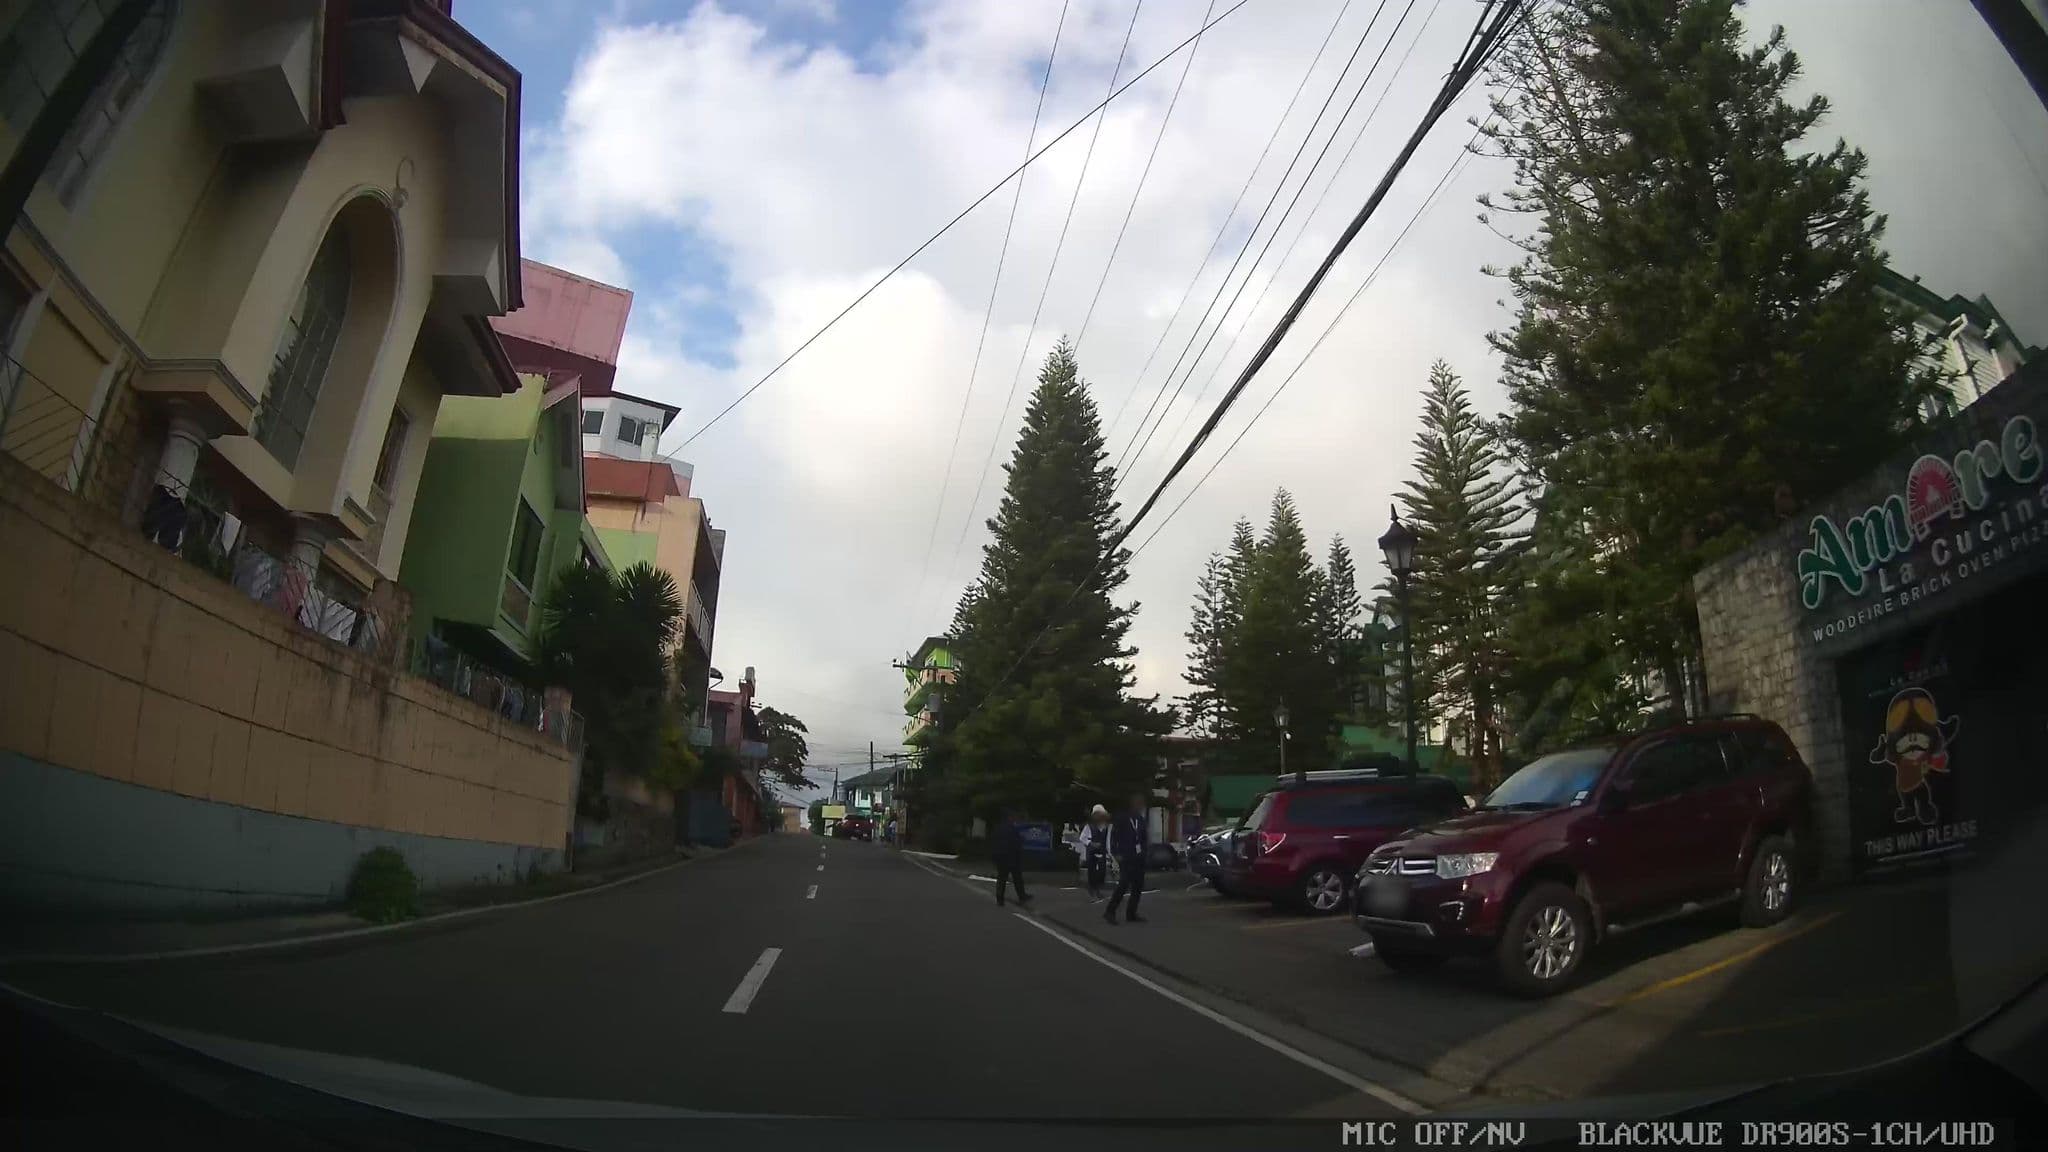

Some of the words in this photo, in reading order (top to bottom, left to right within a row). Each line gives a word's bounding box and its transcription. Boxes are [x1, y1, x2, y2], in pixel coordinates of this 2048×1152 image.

[1814, 599, 1893, 642] WOODFIRE
[1900, 573, 1951, 605] BRICK
[1958, 547, 2005, 578] OVEN
[1865, 837, 1893, 856] THIS
[1897, 829, 1922, 850] WAY
[1928, 820, 1977, 844] PLEASE
